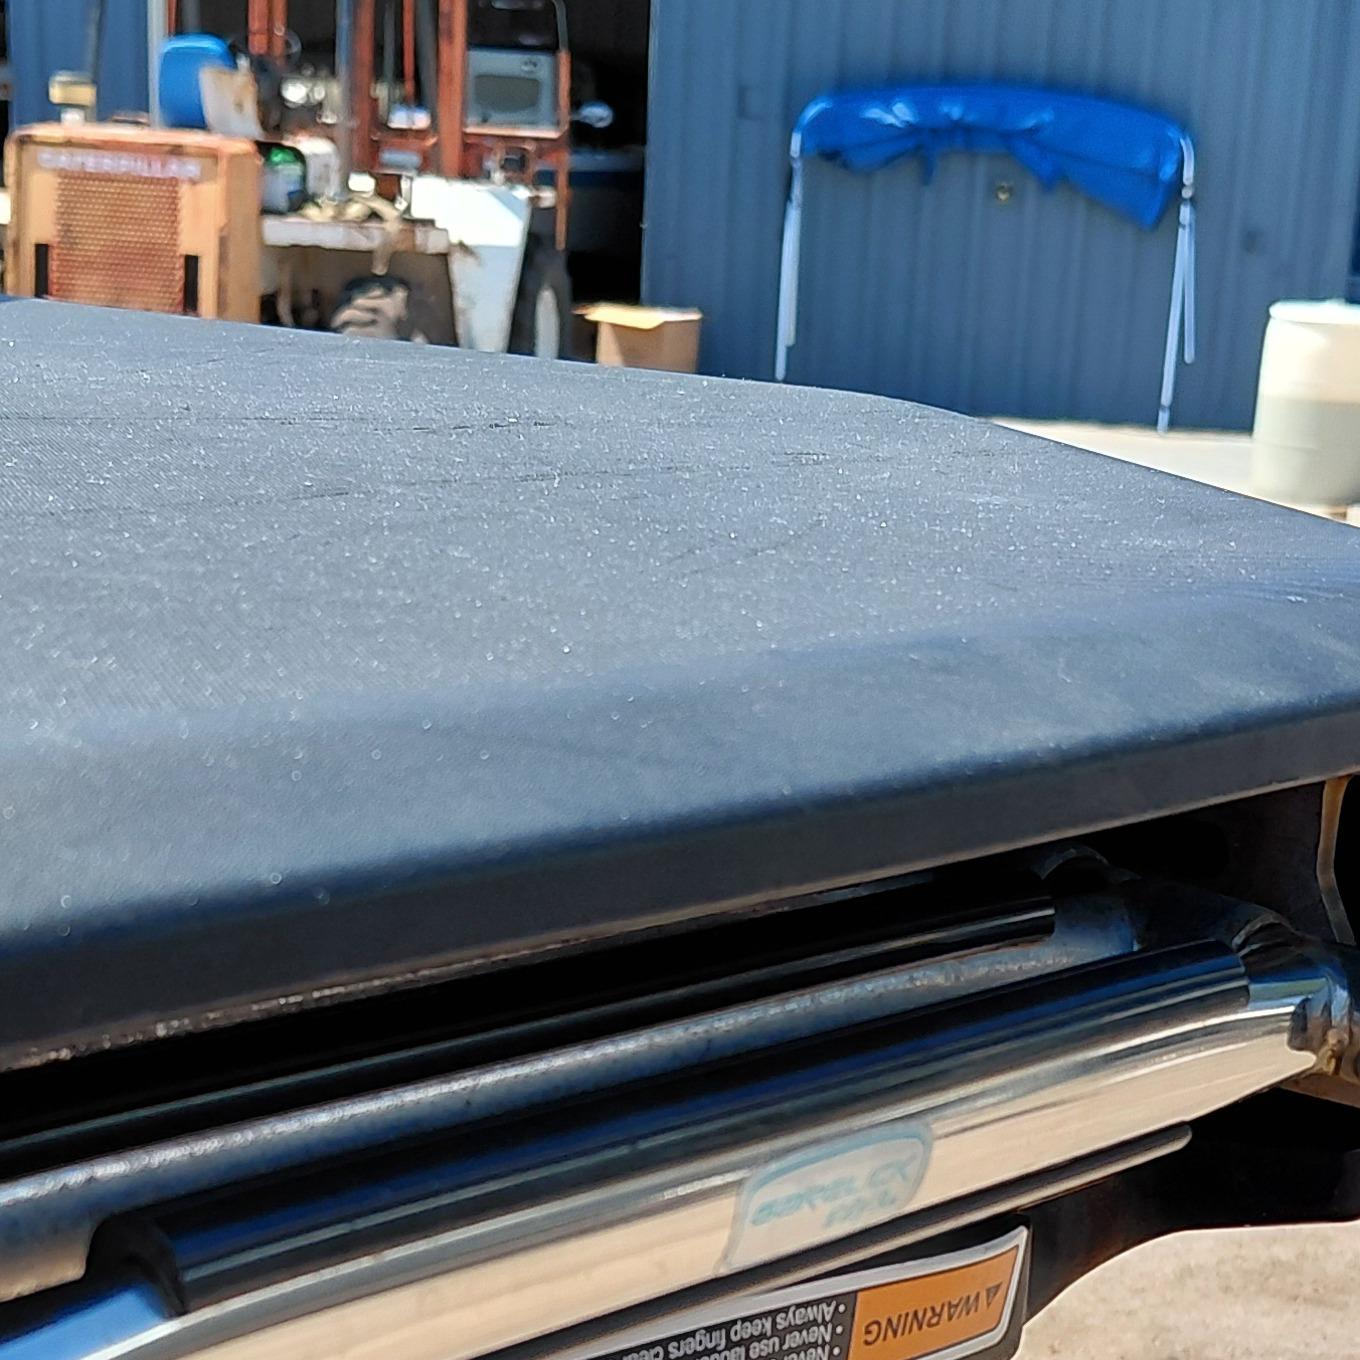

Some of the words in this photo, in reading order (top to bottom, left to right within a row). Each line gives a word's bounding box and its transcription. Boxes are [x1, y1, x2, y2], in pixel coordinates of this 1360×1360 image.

[730, 1316, 772, 1342] keep
[776, 1300, 836, 1330] Always
[864, 1292, 980, 1346] WARNING
[668, 1328, 726, 1360] fingers
[749, 1336, 780, 1359] use
[782, 1322, 832, 1350] Never
